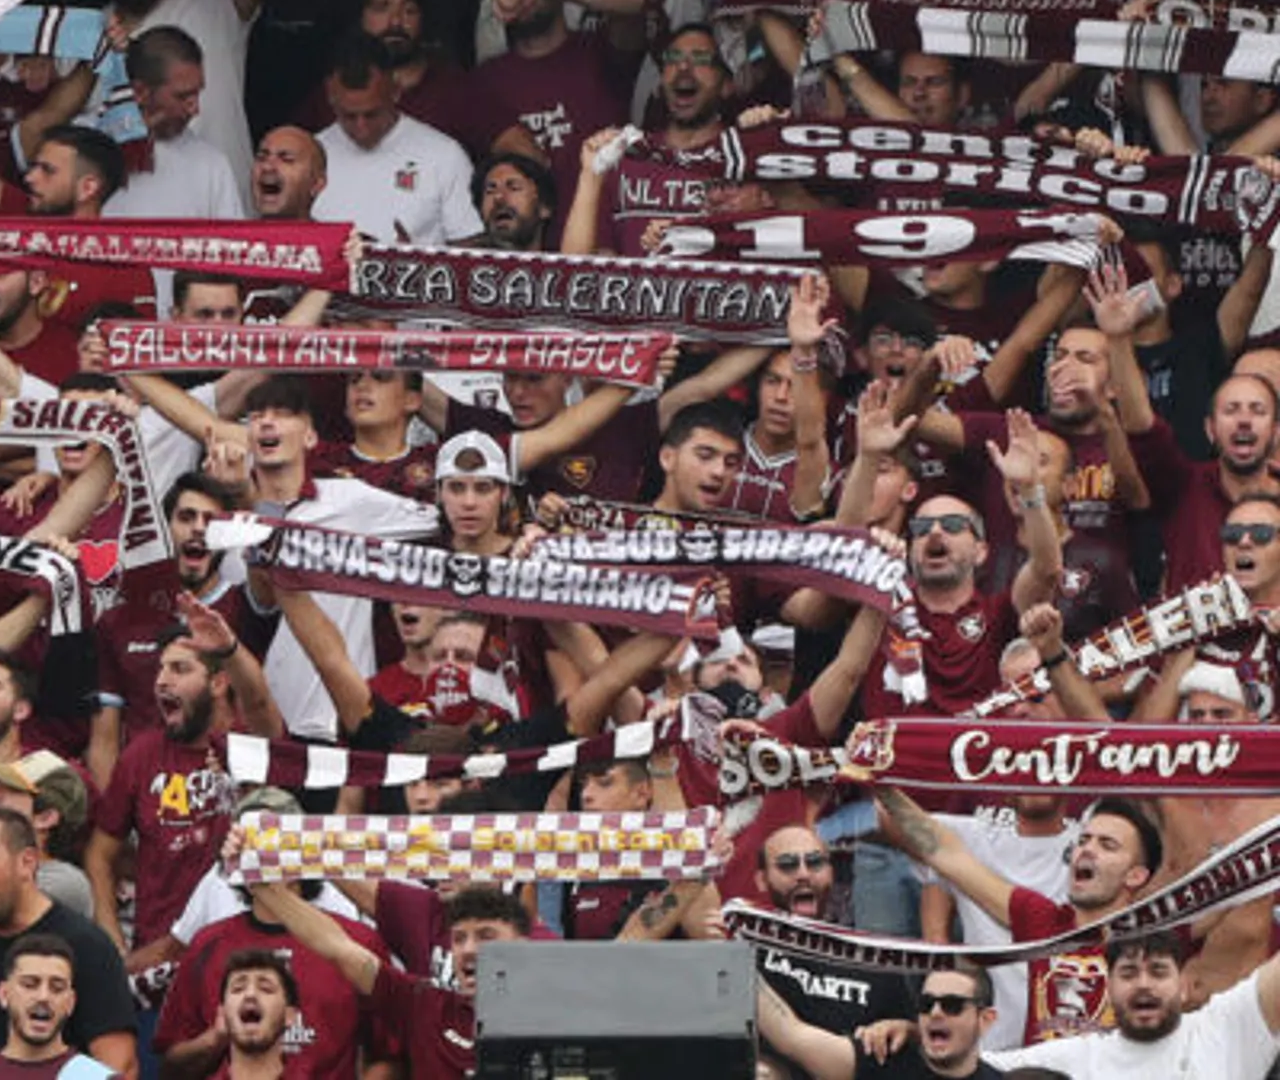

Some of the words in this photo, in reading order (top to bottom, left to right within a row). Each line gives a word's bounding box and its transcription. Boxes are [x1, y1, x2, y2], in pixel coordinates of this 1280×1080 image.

[755, 152, 1170, 216] storico
[469, 264, 795, 320] SALERNITAN
[951, 729, 1240, 784] Cent'anni
